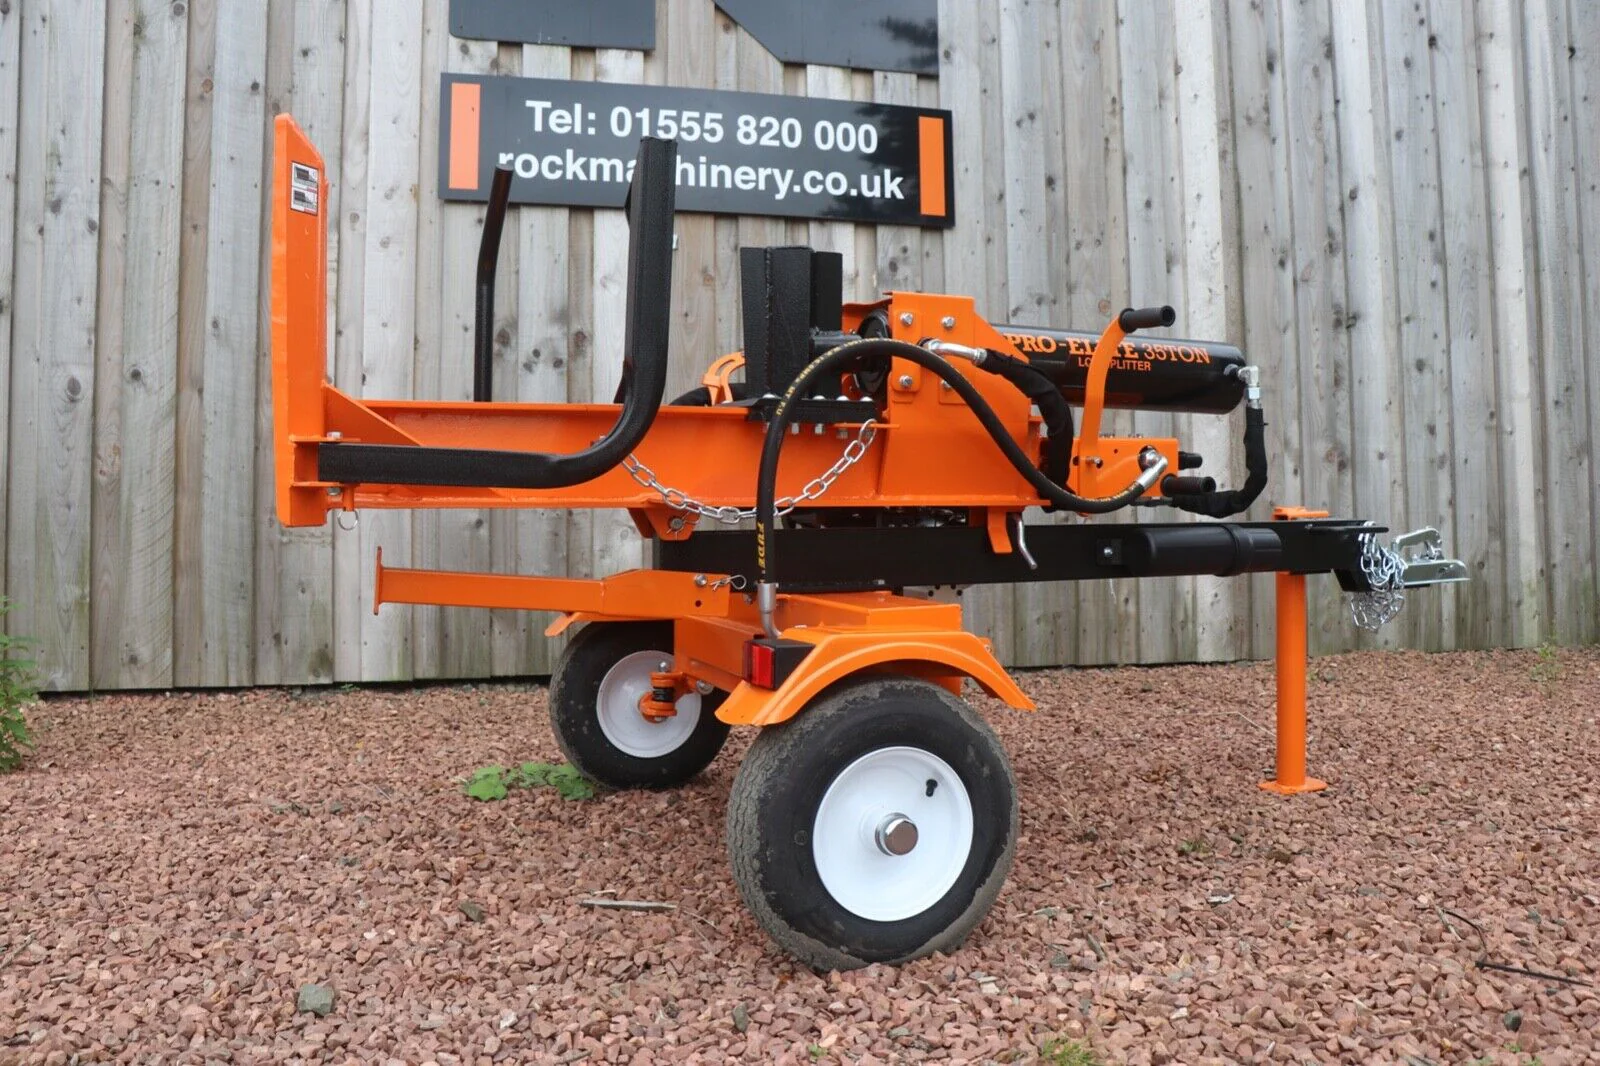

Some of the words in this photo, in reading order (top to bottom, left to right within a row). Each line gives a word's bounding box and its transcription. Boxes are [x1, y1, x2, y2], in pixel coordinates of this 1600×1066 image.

[525, 99, 596, 135] Tel:
[610, 105, 724, 143] 01555
[736, 114, 803, 149] 820
[814, 120, 878, 154] 000
[1141, 342, 1210, 364] 35TON
[1109, 359, 1152, 372] PLITTER
